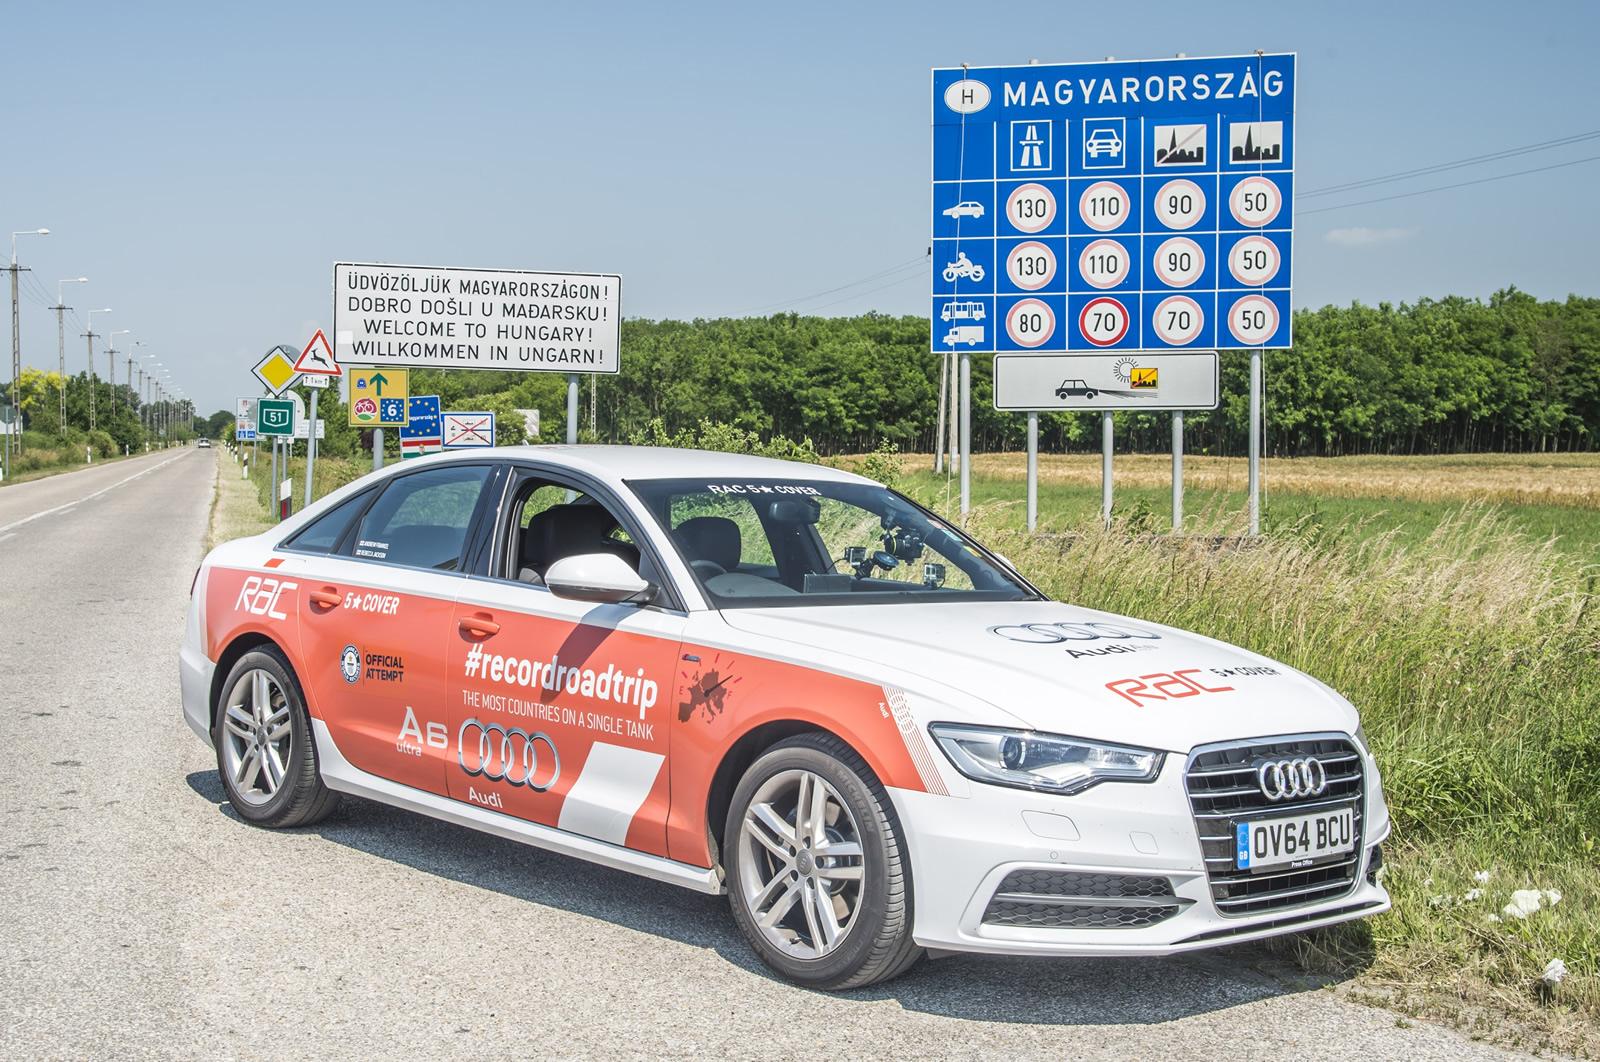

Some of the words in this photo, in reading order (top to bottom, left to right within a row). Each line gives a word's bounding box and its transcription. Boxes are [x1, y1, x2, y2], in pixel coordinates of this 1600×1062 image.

[962, 89, 974, 104] H
[1004, 66, 1284, 108] MAGYARORSZÁG
[1016, 198, 1046, 218] 130
[1090, 196, 1120, 216] 110
[1168, 195, 1192, 214] 90
[1244, 192, 1267, 212] 50
[1016, 256, 1046, 276] 130
[1090, 254, 1118, 274] 110
[1168, 252, 1190, 272] 90
[1244, 250, 1266, 270] 50
[348, 272, 450, 294] ÜDVÖZÖLJÜK
[349, 296, 411, 314] DOBRO
[421, 298, 472, 316] DOŠLI
[482, 302, 493, 317] U
[364, 319, 456, 337] WELCOME
[464, 322, 486, 338] TO
[1020, 314, 1042, 333] 80
[1094, 312, 1116, 332] 70
[1168, 311, 1190, 330] 70
[1242, 310, 1266, 330] 50
[352, 340, 479, 360] WILLKOMMEN
[490, 346, 508, 360] IN
[270, 412, 282, 422] 51
[387, 404, 397, 416] 6
[708, 484, 746, 494] RAC
[746, 484, 760, 494] 5
[774, 486, 822, 496] COVER
[344, 592, 354, 609] 5
[362, 592, 400, 614] COVER
[366, 654, 404, 668] OFFICIAL
[1065, 644, 1136, 658] Audi
[366, 668, 404, 682] ATTEMPT
[1234, 666, 1282, 676] COVER
[464, 643, 658, 720] #recordroadtrip
[462, 690, 480, 708] THE
[482, 692, 506, 712] MOST
[508, 698, 560, 723] COUNTRIES
[562, 708, 576, 726] ON
[578, 711, 585, 727] A
[587, 713, 623, 735] SINGLE
[626, 720, 654, 741] TANK
[398, 706, 448, 749] A6
[396, 741, 422, 756] ultra
[469, 786, 503, 808] Audi
[1254, 820, 1310, 858] OV64
[1316, 813, 1350, 850] BCU
[1240, 850, 1248, 860] GB
